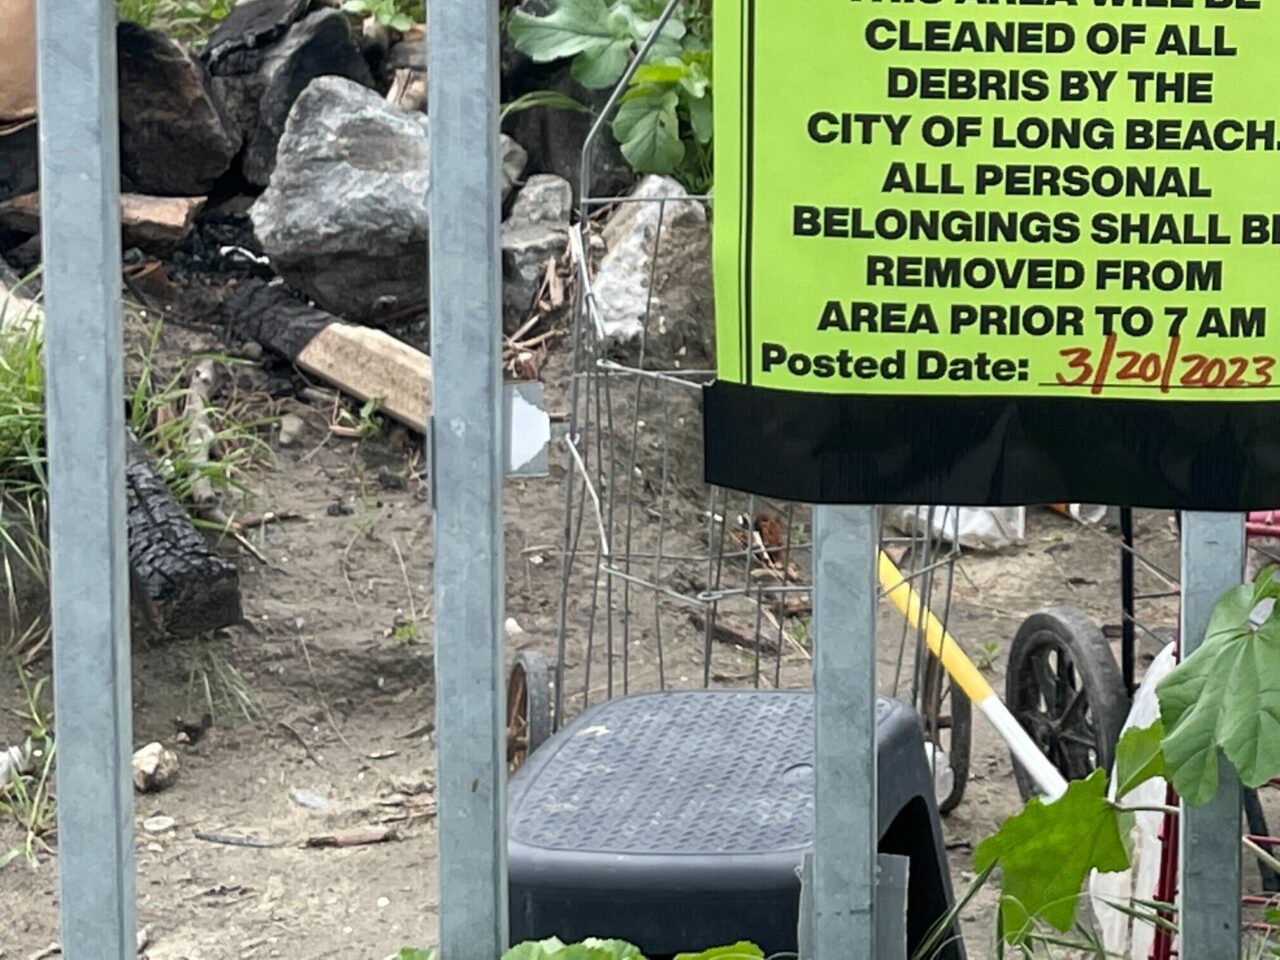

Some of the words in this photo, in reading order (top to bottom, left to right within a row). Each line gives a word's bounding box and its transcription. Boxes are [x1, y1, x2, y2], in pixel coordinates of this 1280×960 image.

[865, 19, 1075, 54] CLEANED
[1086, 23, 1148, 55] OF
[1156, 25, 1237, 57] ALL
[888, 67, 1048, 101] DEBRIS
[1061, 71, 1117, 101] BY
[1128, 72, 1213, 103] THE
[808, 112, 911, 145] CITY
[922, 116, 981, 147] OF
[993, 118, 1113, 149] LONG
[882, 162, 964, 194] ALL
[976, 165, 1211, 197] PERSONAL
[794, 206, 1080, 243] BELONGINGS
[1091, 213, 1230, 244] SHALL
[867, 256, 1084, 289] REMOVED
[1096, 260, 1222, 291] FROM
[817, 301, 939, 334] AREA
[951, 305, 1083, 336] PRIOR
[1095, 306, 1153, 337] TO
[1165, 307, 1188, 337] 7
[1197, 308, 1265, 337] AM
[762, 343, 905, 379] Posted
[917, 350, 1028, 381] Date:
[1055, 332, 1275, 395] 3/20/2023
